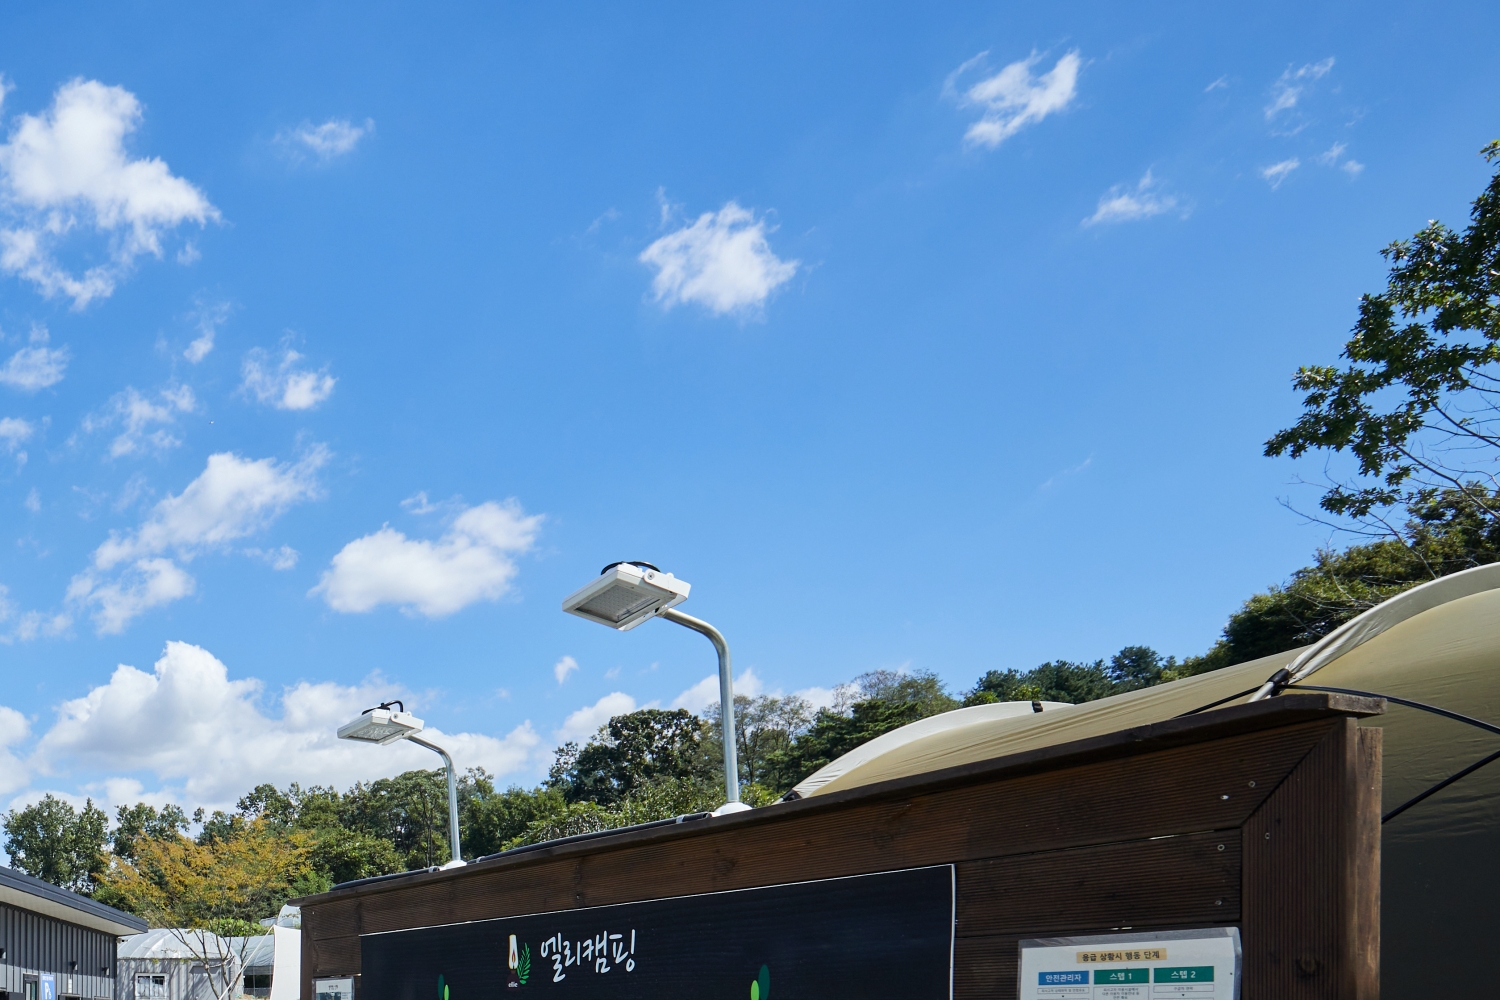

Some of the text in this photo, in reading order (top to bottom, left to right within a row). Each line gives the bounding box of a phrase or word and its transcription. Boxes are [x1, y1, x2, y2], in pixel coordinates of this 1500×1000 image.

[540, 928, 636, 983] 엘리캠핑
[1082, 950, 1160, 962] 응급 상황시 행동 단계
[1045, 974, 1082, 982] 안전관리자
[1109, 972, 1125, 981] 스텝
[1171, 970, 1196, 979] 스텝 2
